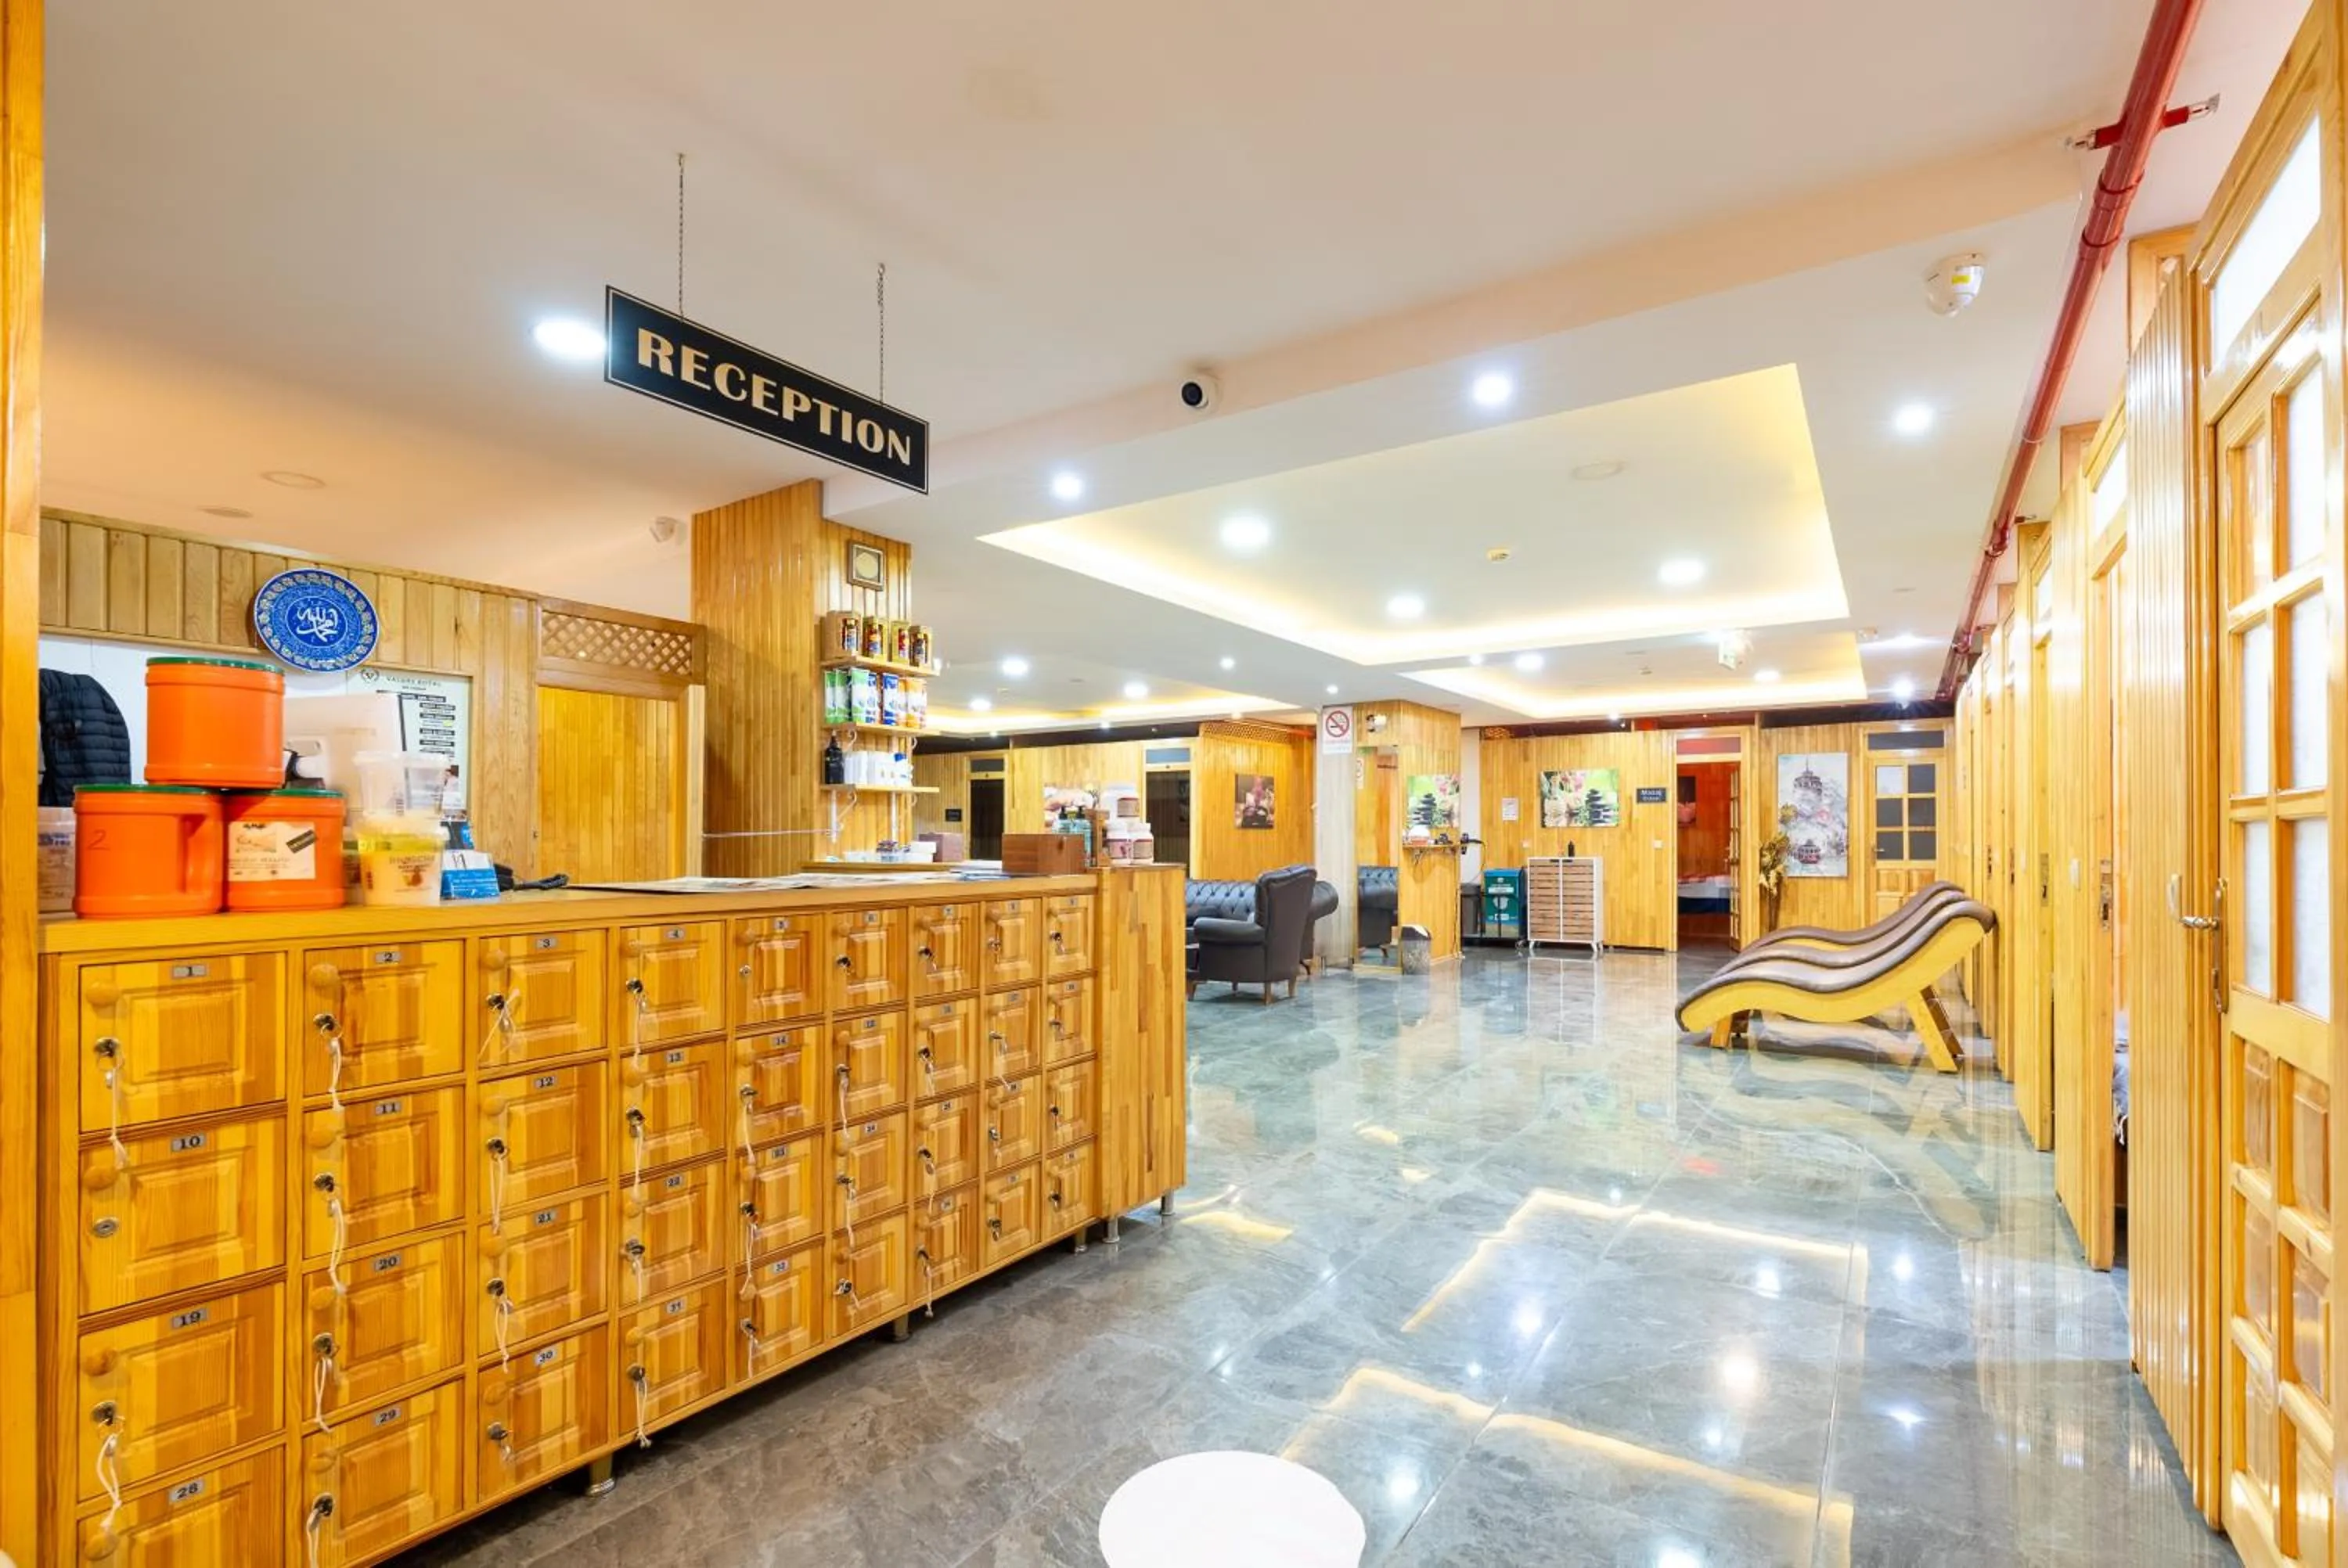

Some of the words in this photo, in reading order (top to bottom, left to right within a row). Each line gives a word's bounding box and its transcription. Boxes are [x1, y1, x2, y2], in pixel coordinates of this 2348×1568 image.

[637, 328, 911, 466] RECEPTION
[88, 829, 110, 851] 2
[542, 939, 549, 948] 3
[384, 952, 392, 962] 2
[540, 1077, 553, 1088] 12
[382, 1103, 394, 1114] 11
[180, 1135, 200, 1149] 10
[538, 1214, 550, 1224] 21
[379, 1257, 396, 1270] 20
[181, 1311, 200, 1326] 19
[539, 1350, 553, 1362] 30
[380, 1409, 396, 1423] 29
[175, 1483, 198, 1499] 28
